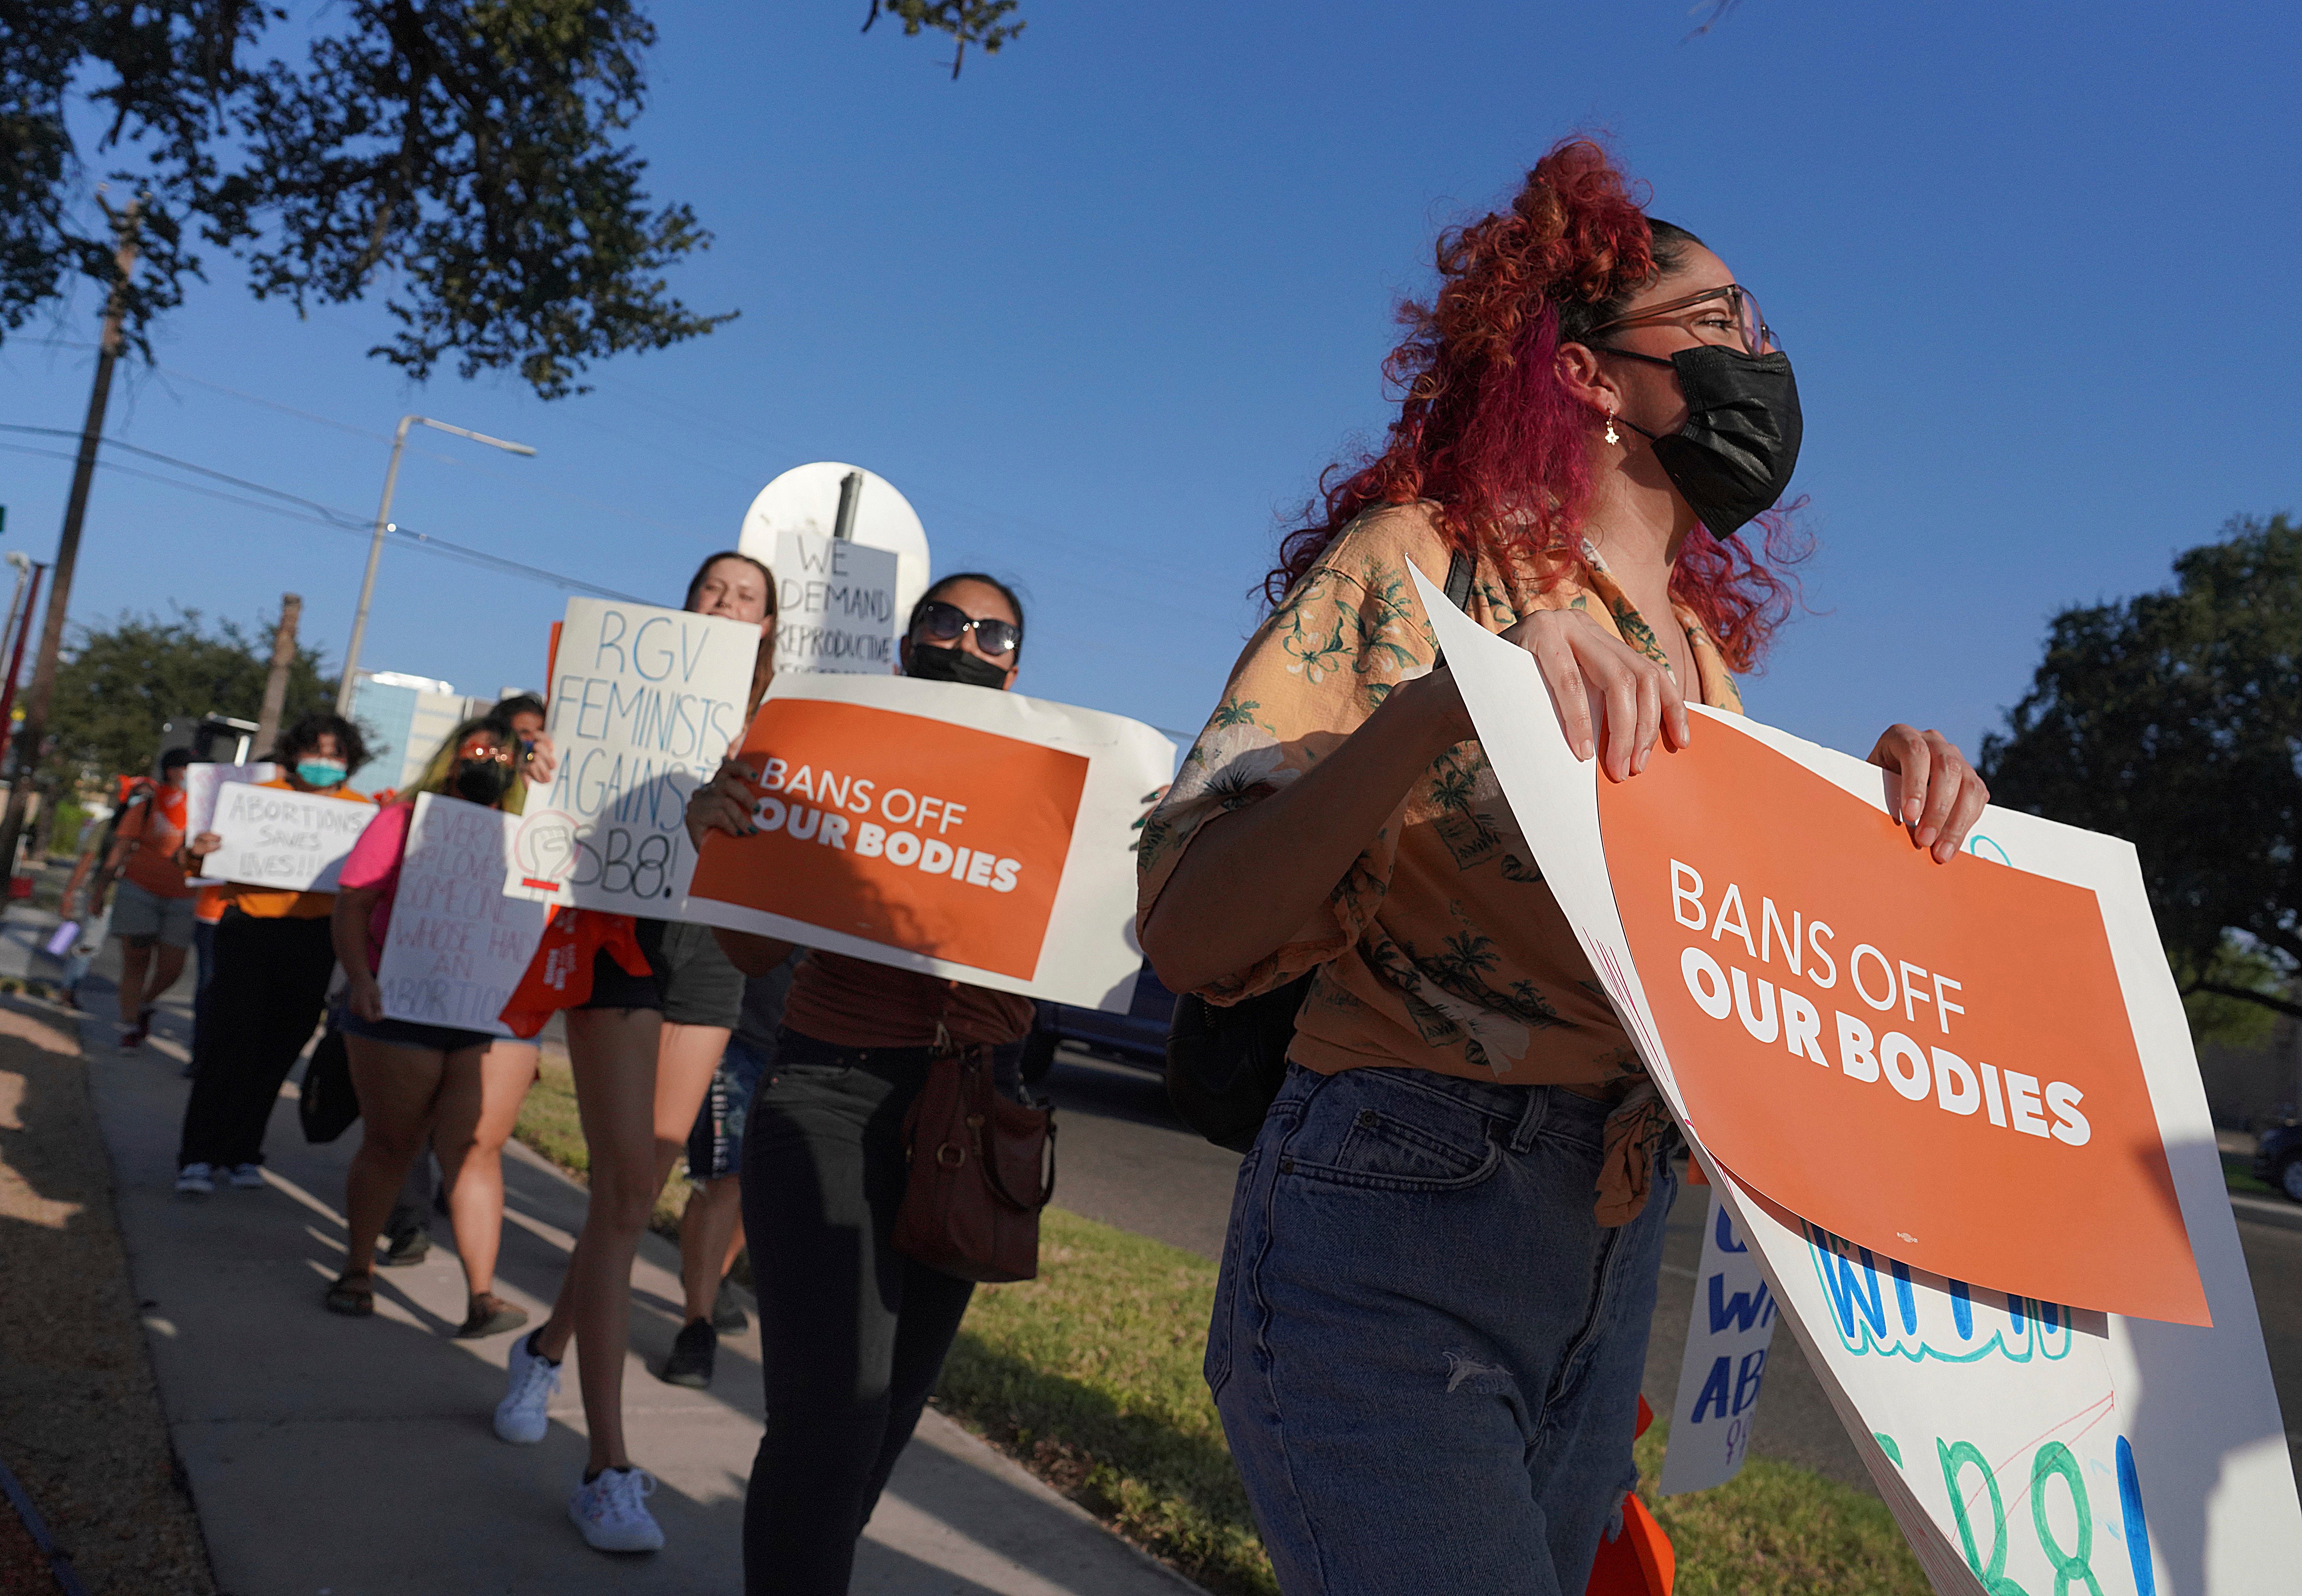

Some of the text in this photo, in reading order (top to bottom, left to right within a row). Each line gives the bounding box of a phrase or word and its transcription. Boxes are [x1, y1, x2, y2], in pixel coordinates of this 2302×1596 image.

[797, 535, 849, 577] WE
[779, 578, 893, 622] DEMAND
[595, 610, 710, 682] RGV
[551, 674, 734, 765] FEMINISTS
[228, 793, 364, 832] ABORTIONS
[760, 757, 967, 834] BANS OFF
[751, 797, 1022, 893] OUR BODIES
[1670, 858, 1965, 1034] BANS OFF
[386, 977, 510, 1025] ABORTIO
[1680, 947, 2091, 1146] OUR BODIES
